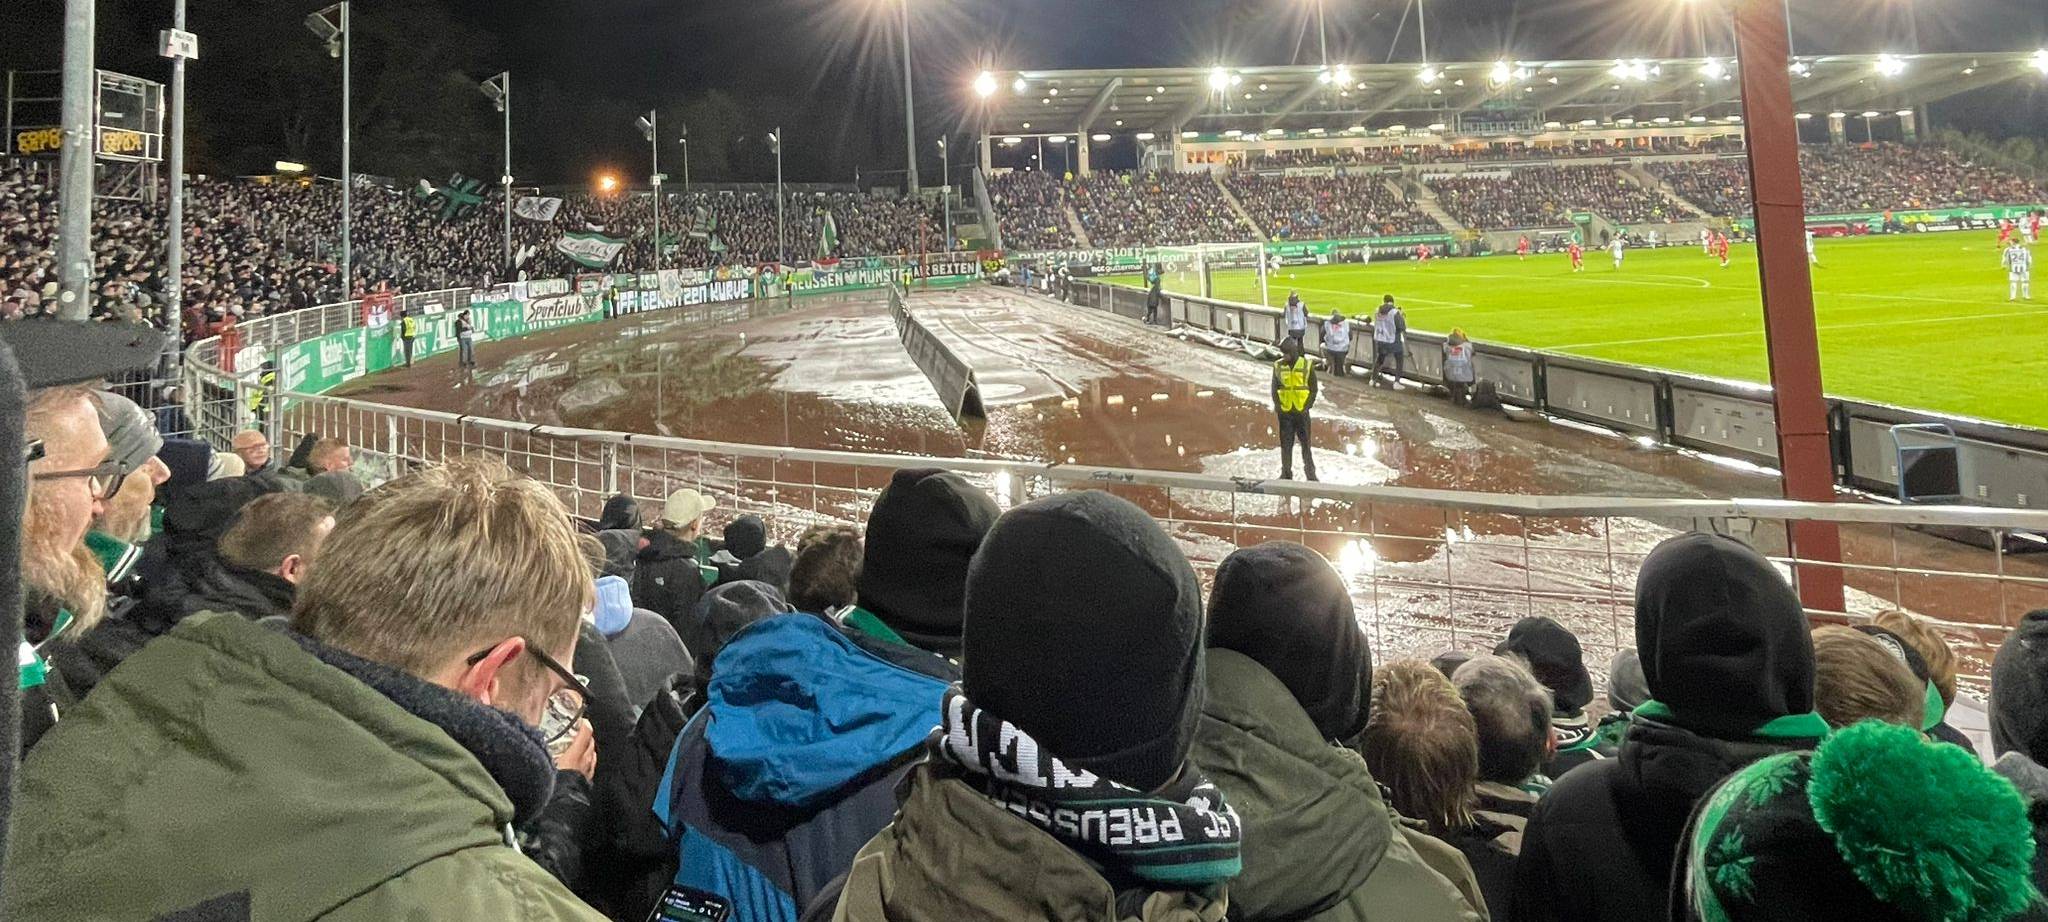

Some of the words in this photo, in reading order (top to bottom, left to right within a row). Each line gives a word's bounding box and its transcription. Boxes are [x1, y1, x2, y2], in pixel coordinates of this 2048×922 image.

[2011, 252, 2025, 263] 24
[932, 262, 975, 276] BEXTEN
[527, 295, 582, 321] Sportclub
